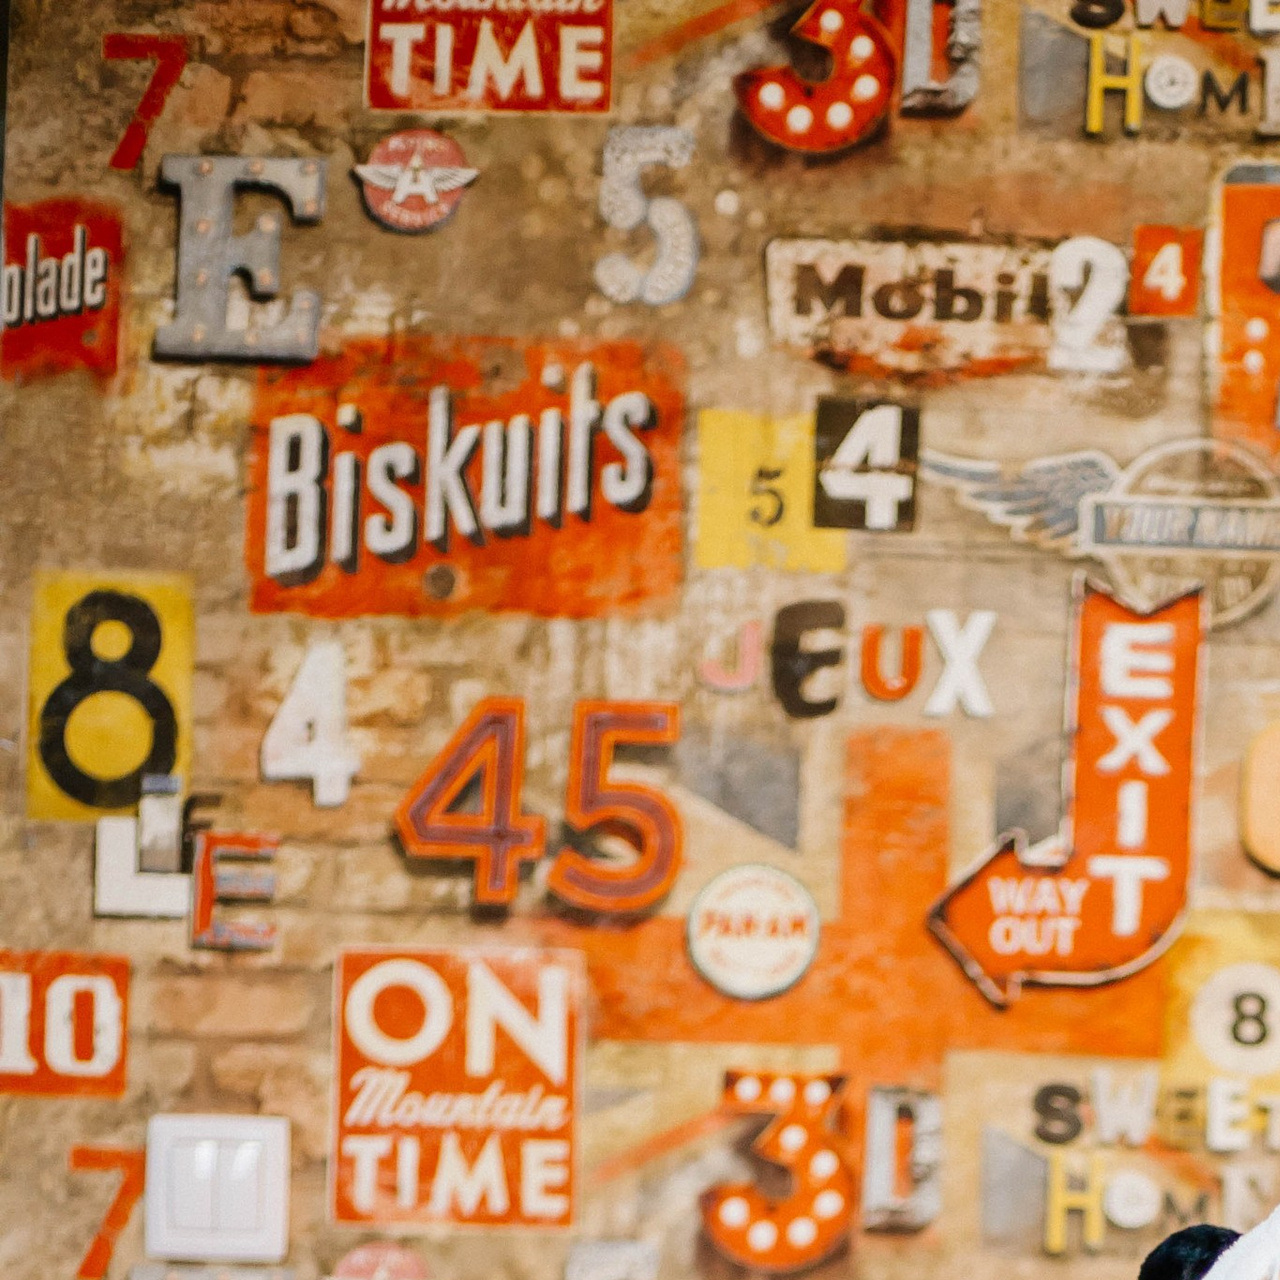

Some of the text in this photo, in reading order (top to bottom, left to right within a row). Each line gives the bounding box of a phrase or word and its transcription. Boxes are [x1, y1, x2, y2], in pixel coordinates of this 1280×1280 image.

[103, 34, 190, 170] 7
[378, 20, 606, 100] TIME
[155, 155, 326, 362] E
[594, 125, 697, 305] 5
[264, 360, 662, 590] Biskuits
[751, 468, 785, 526] 5
[819, 403, 914, 532] 4
[37, 588, 180, 810] 8
[261, 640, 362, 808] 4
[1088, 620, 1178, 938] EXIT
[986, 876, 1092, 916] WAY
[988, 918, 1082, 956] OUT
[344, 956, 570, 1086] ON
[1229, 992, 1269, 1047] 8
[344, 1064, 568, 1130] Mountain
[342, 1132, 570, 1218] TIME
